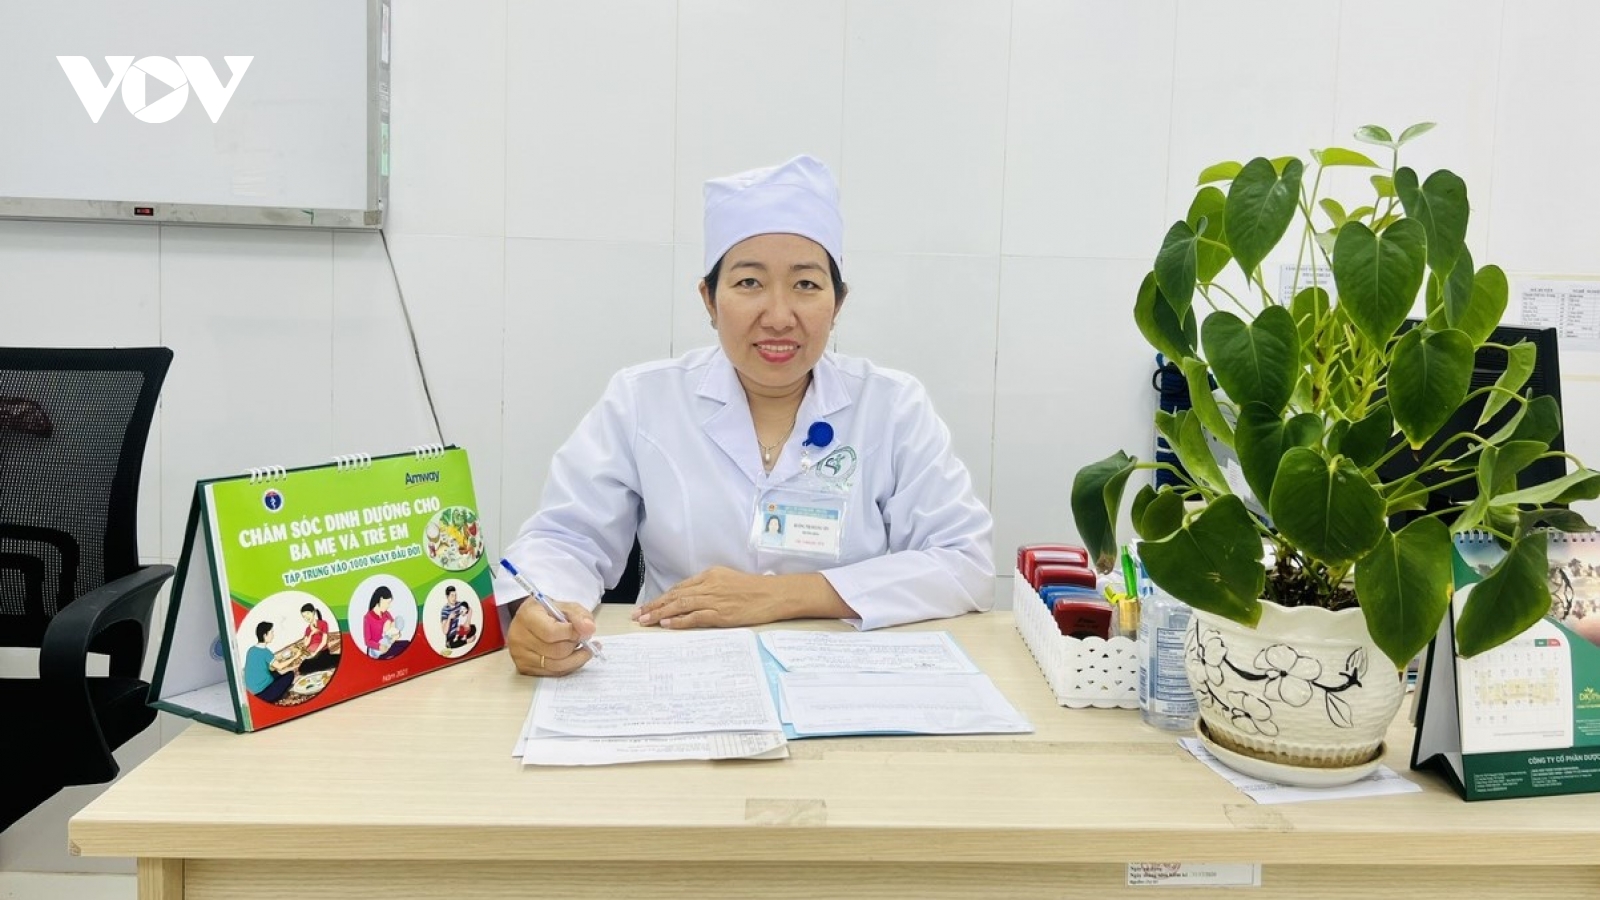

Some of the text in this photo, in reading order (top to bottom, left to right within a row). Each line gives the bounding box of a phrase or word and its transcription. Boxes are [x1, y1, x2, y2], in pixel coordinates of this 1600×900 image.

[405, 471, 440, 485] Amway
[289, 515, 323, 539] SÓC
[324, 509, 360, 532] DINH
[413, 496, 440, 515] CHO
[289, 538, 312, 562] BÀ
[313, 536, 338, 558] MẸ
[338, 530, 360, 551] VÀ
[389, 523, 409, 542] EM
[302, 565, 330, 580] TRUNG
[350, 557, 368, 569] 1000
[1527, 756, 1546, 765] CÔNG
[1546, 755, 1556, 764] TY
